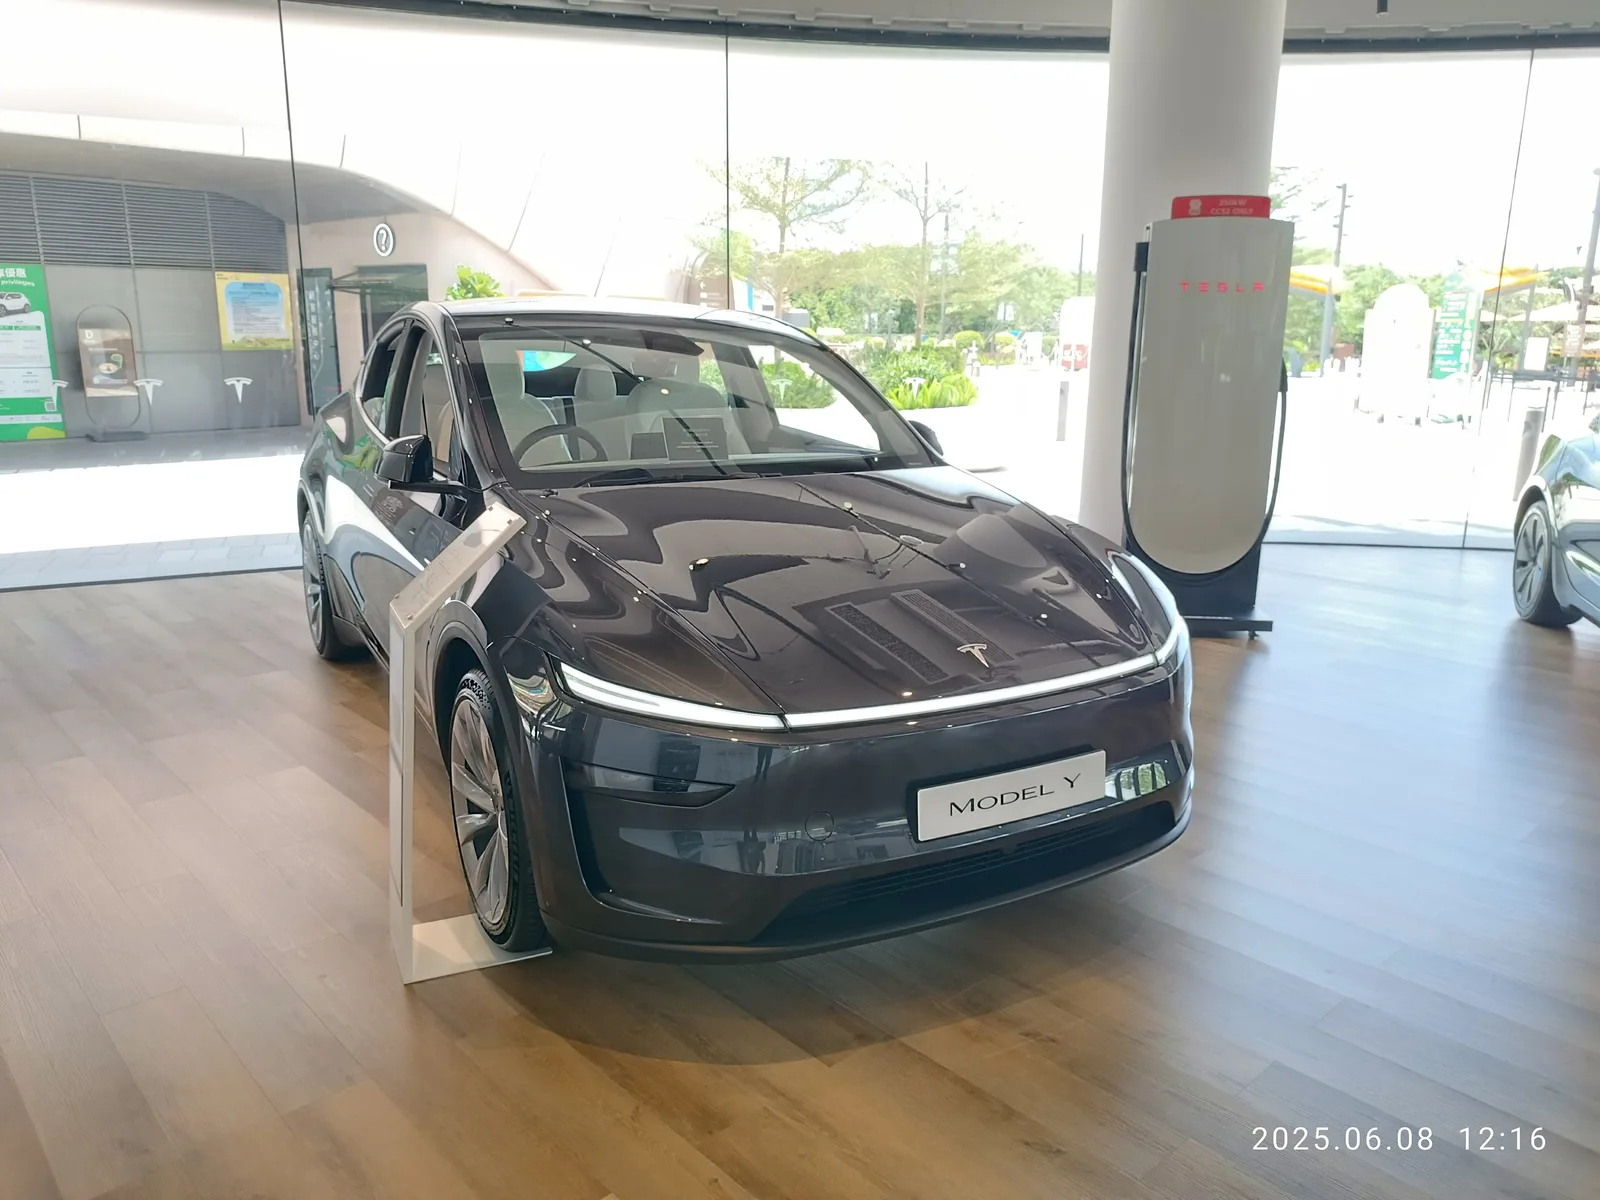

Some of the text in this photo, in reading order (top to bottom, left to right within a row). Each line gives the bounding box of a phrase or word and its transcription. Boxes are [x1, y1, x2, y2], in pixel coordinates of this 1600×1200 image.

[1180, 282, 1264, 292] TESLA
[949, 772, 1082, 817] MODEL Y
